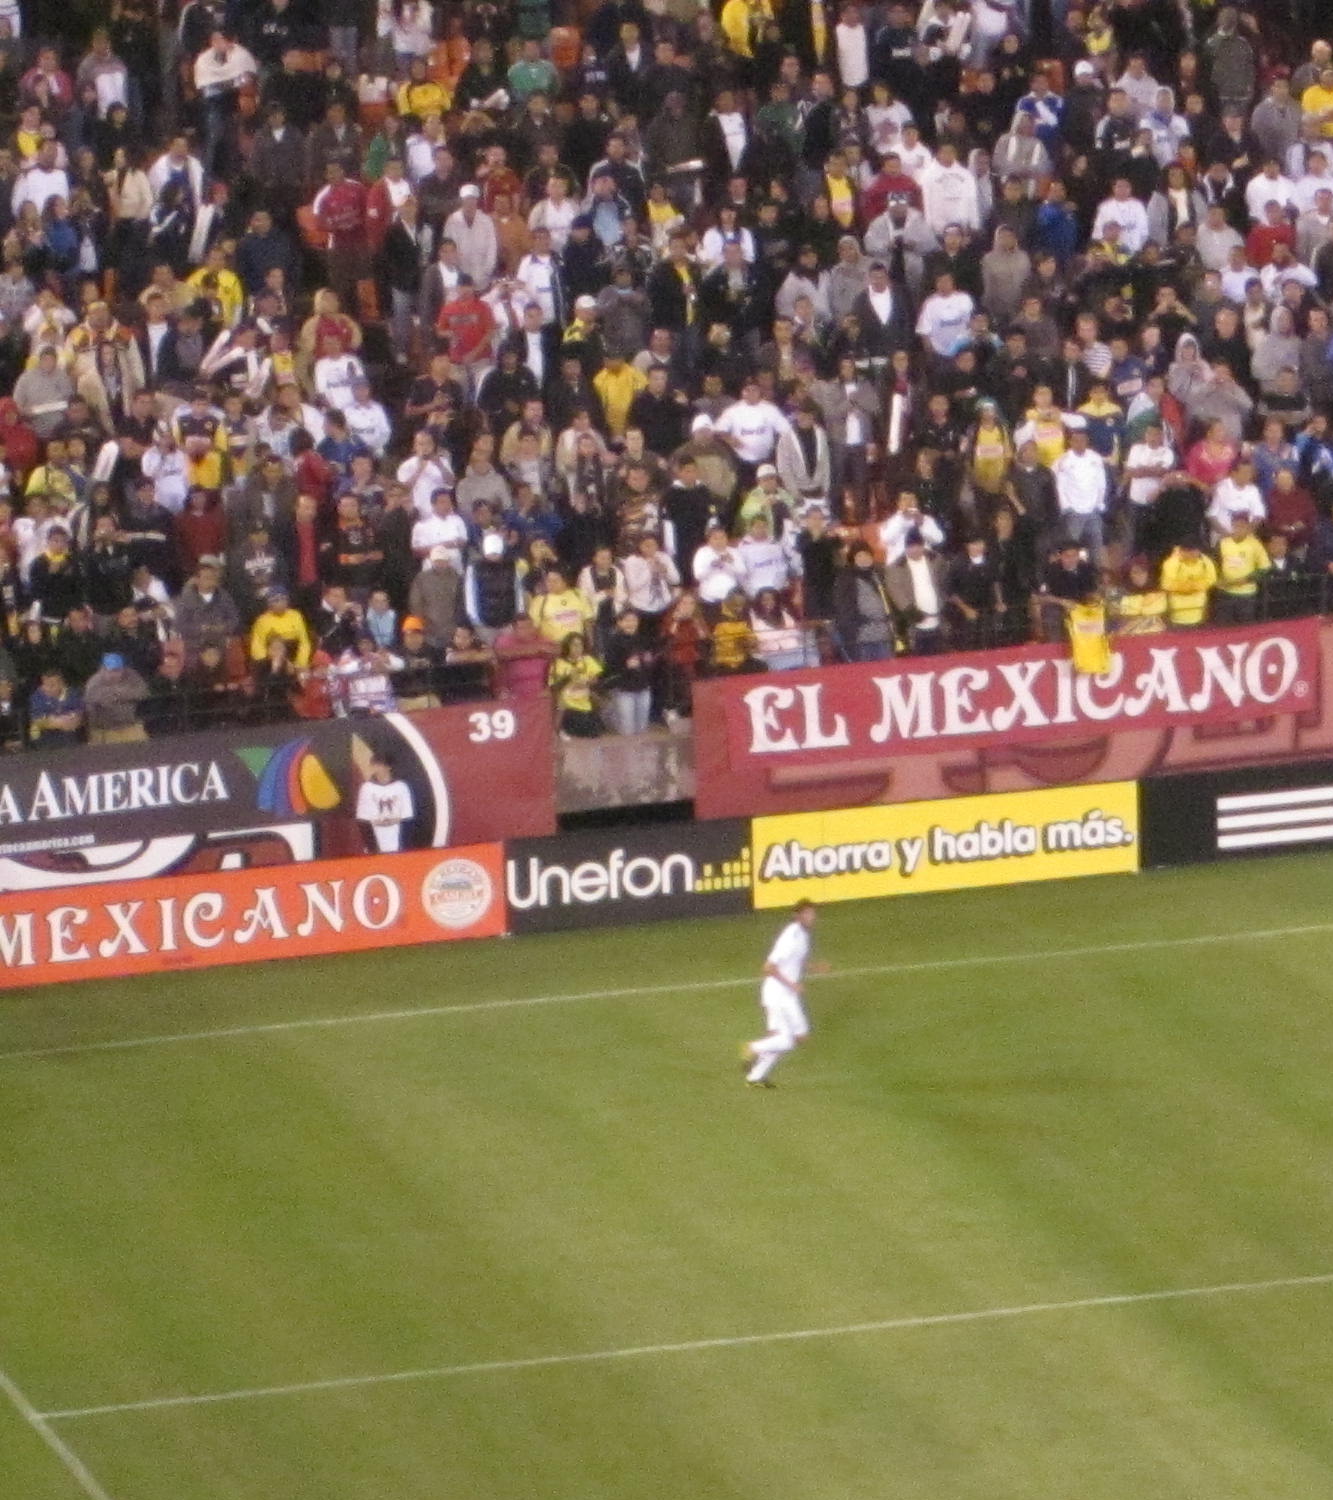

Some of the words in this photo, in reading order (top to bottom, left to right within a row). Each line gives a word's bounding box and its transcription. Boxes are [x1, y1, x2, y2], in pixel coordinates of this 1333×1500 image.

[744, 683, 850, 753] EL
[869, 637, 1298, 743] MEXICANO
[468, 710, 516, 743] 39
[28, 761, 230, 821] AMERICA
[760, 839, 893, 882] Ahorra
[899, 837, 923, 877] y
[930, 817, 1037, 866] habla
[1045, 807, 1135, 851] más.
[507, 848, 694, 909] Unefon
